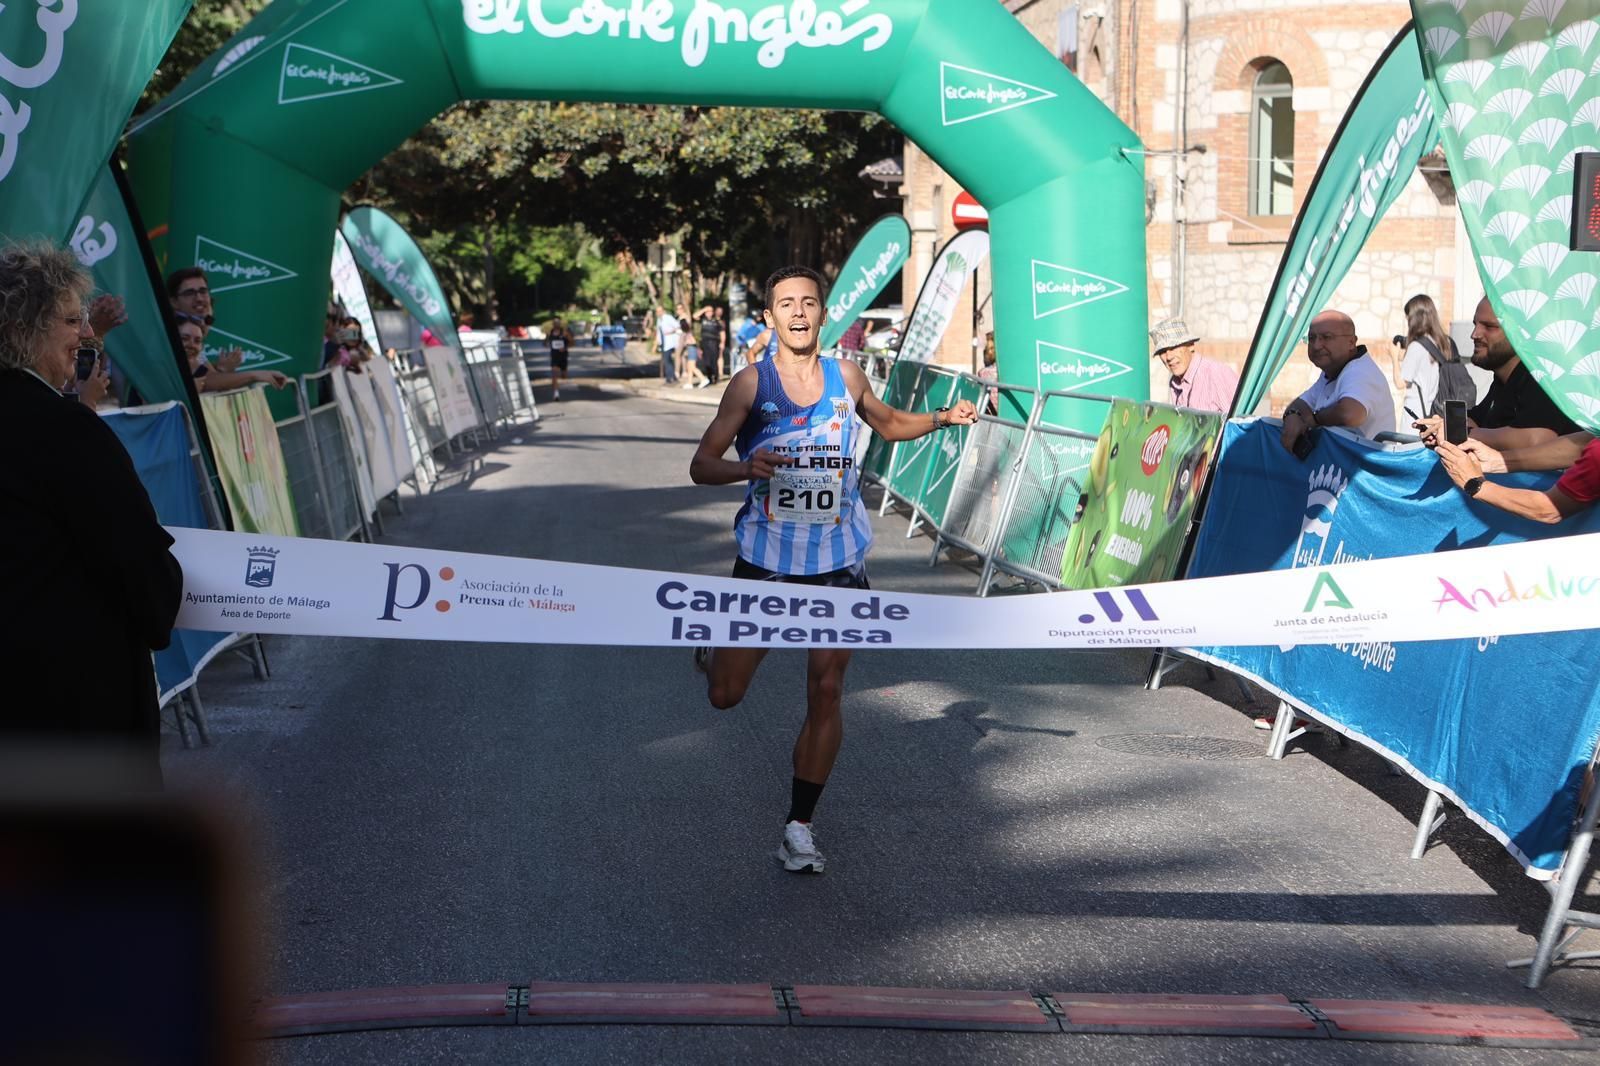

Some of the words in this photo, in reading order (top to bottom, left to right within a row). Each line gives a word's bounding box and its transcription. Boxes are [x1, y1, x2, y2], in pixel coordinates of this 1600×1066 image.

[526, 0, 675, 42] Corte
[680, 0, 894, 69] Inglés
[299, 65, 328, 79] Corte
[327, 64, 370, 86] Inglés
[945, 86, 958, 99] El
[958, 86, 986, 99] Corte
[986, 82, 1027, 104] Inglés
[840, 279, 868, 310] Corte
[860, 242, 900, 289] Inglés
[1047, 281, 1071, 294] Corte
[1071, 278, 1106, 297] Inglés
[1052, 362, 1076, 374] Corte
[1076, 359, 1110, 378] Inglés
[773, 444, 840, 453] ATLETISMO
[778, 488, 834, 511] 210
[1120, 488, 1155, 531] 100%
[460, 579, 530, 595] Asociación
[533, 584, 550, 596] de
[552, 585, 564, 597] la
[185, 591, 266, 606] Ayuntamiento
[269, 595, 284, 606] de
[287, 596, 331, 610] Málaga
[459, 593, 505, 607] Prensa
[508, 597, 524, 609] de
[528, 599, 576, 613] Málaga
[656, 581, 835, 618] Carrera
[850, 596, 910, 621] de
[220, 607, 241, 618] Área
[243, 609, 254, 618] de
[256, 610, 292, 621] Deporte
[1273, 618, 1308, 628] Junta
[1310, 615, 1325, 625] de
[1327, 610, 1389, 624] Andalucía
[671, 616, 712, 641] la
[729, 620, 893, 644] Prensa
[1048, 628, 1125, 639] Diputación
[1128, 626, 1196, 636] Provincial
[1087, 637, 1101, 645] de
[1109, 637, 1161, 646] Málaga
